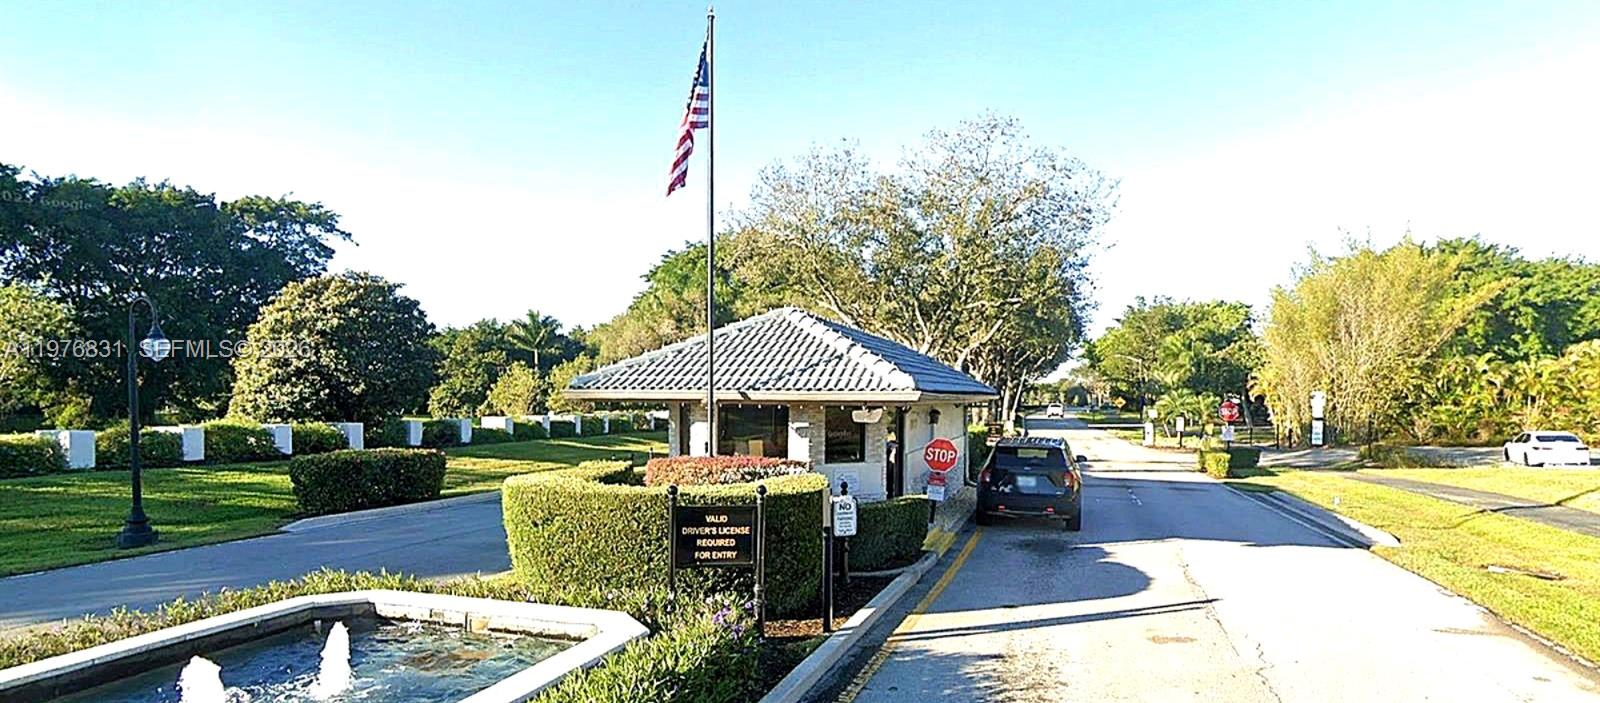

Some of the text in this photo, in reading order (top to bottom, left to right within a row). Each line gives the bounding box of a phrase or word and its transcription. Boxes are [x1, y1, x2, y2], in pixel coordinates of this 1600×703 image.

[925, 447, 956, 463] STOP
[839, 502, 852, 511] NO
[705, 515, 728, 523] VALID
[682, 526, 751, 535] DRIVER'S LICENSE
[696, 539, 736, 547] REQUIRED
[694, 551, 738, 560] FOR ENTRY
